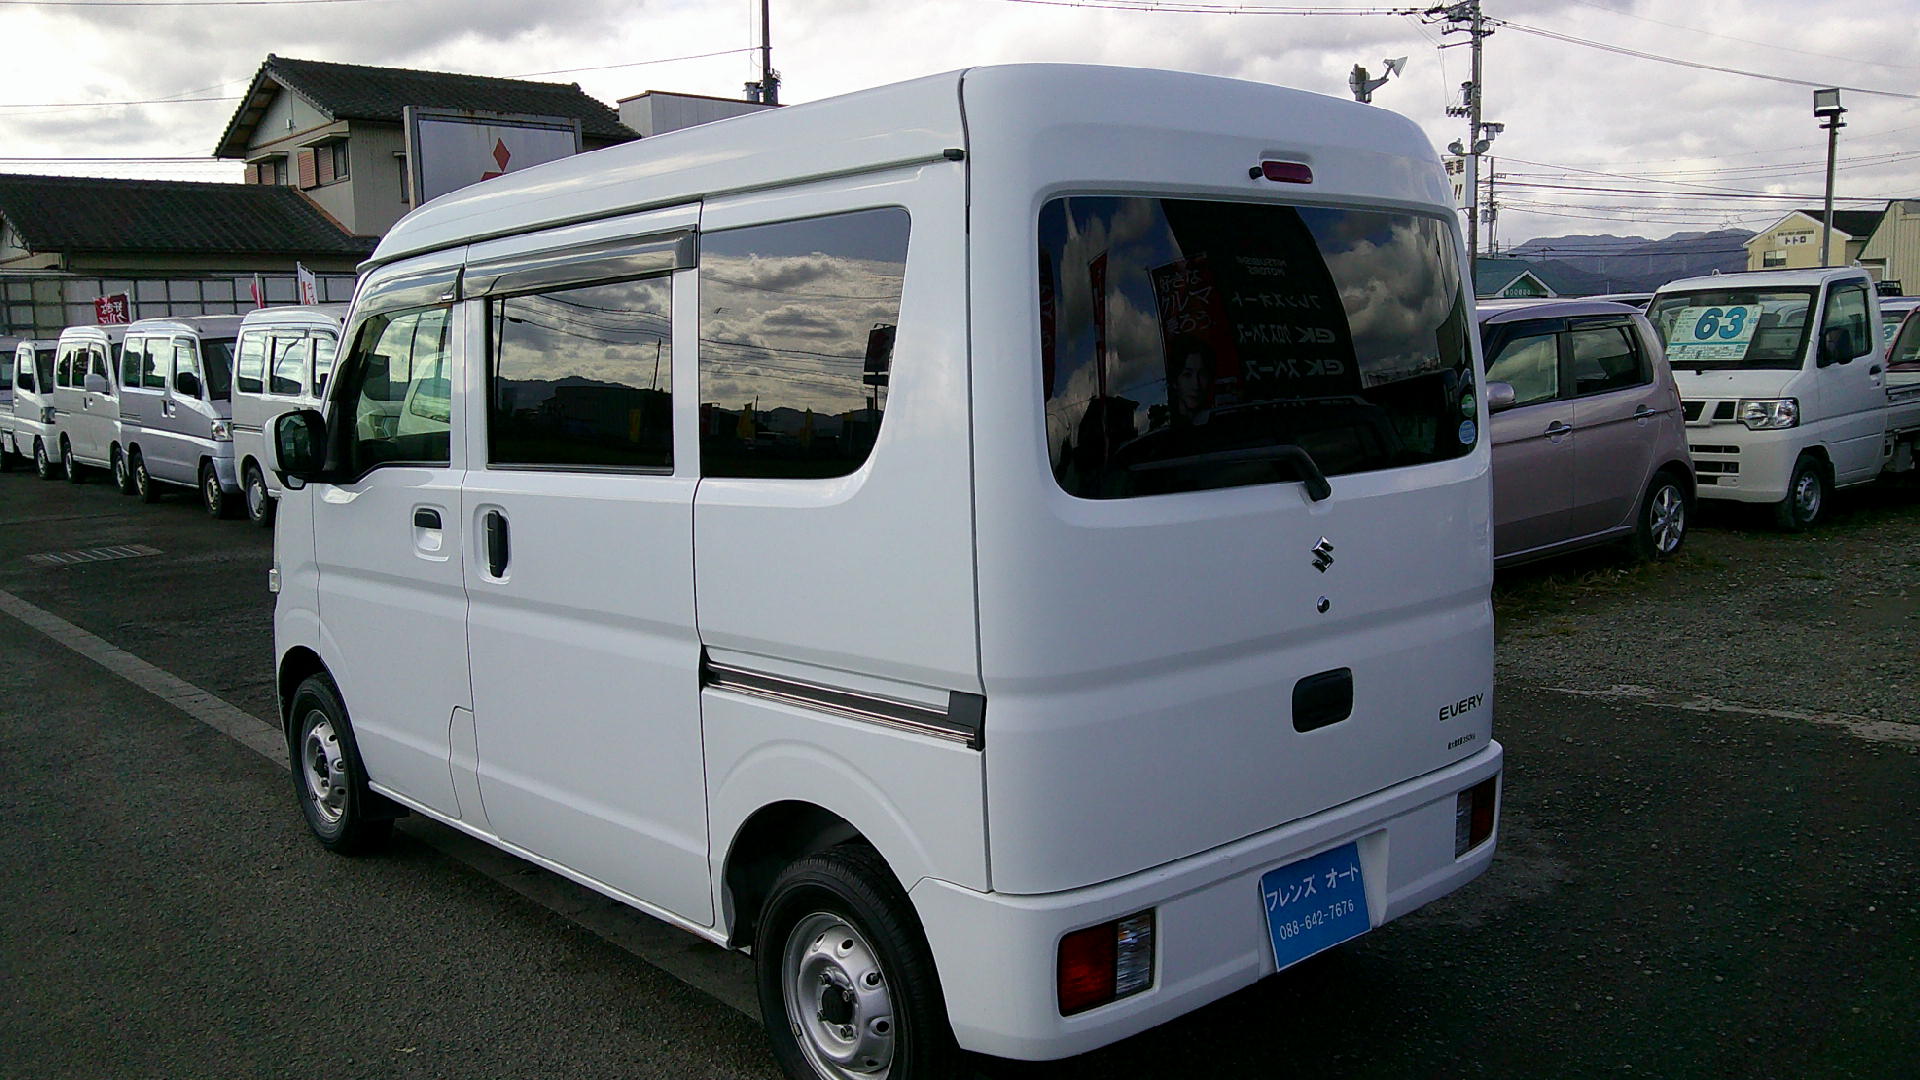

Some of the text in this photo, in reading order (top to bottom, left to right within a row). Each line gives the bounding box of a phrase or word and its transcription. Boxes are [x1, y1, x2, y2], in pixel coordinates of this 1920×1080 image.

[1785, 235, 1806, 245] トトロ
[1158, 269, 1202, 293] 好きな
[1161, 286, 1213, 316] クルマ
[1694, 306, 1747, 340] 63
[1439, 692, 1484, 721] EVERY
[1266, 863, 1359, 912] フレンズ オート
[1279, 899, 1354, 940] 088-642-7676
